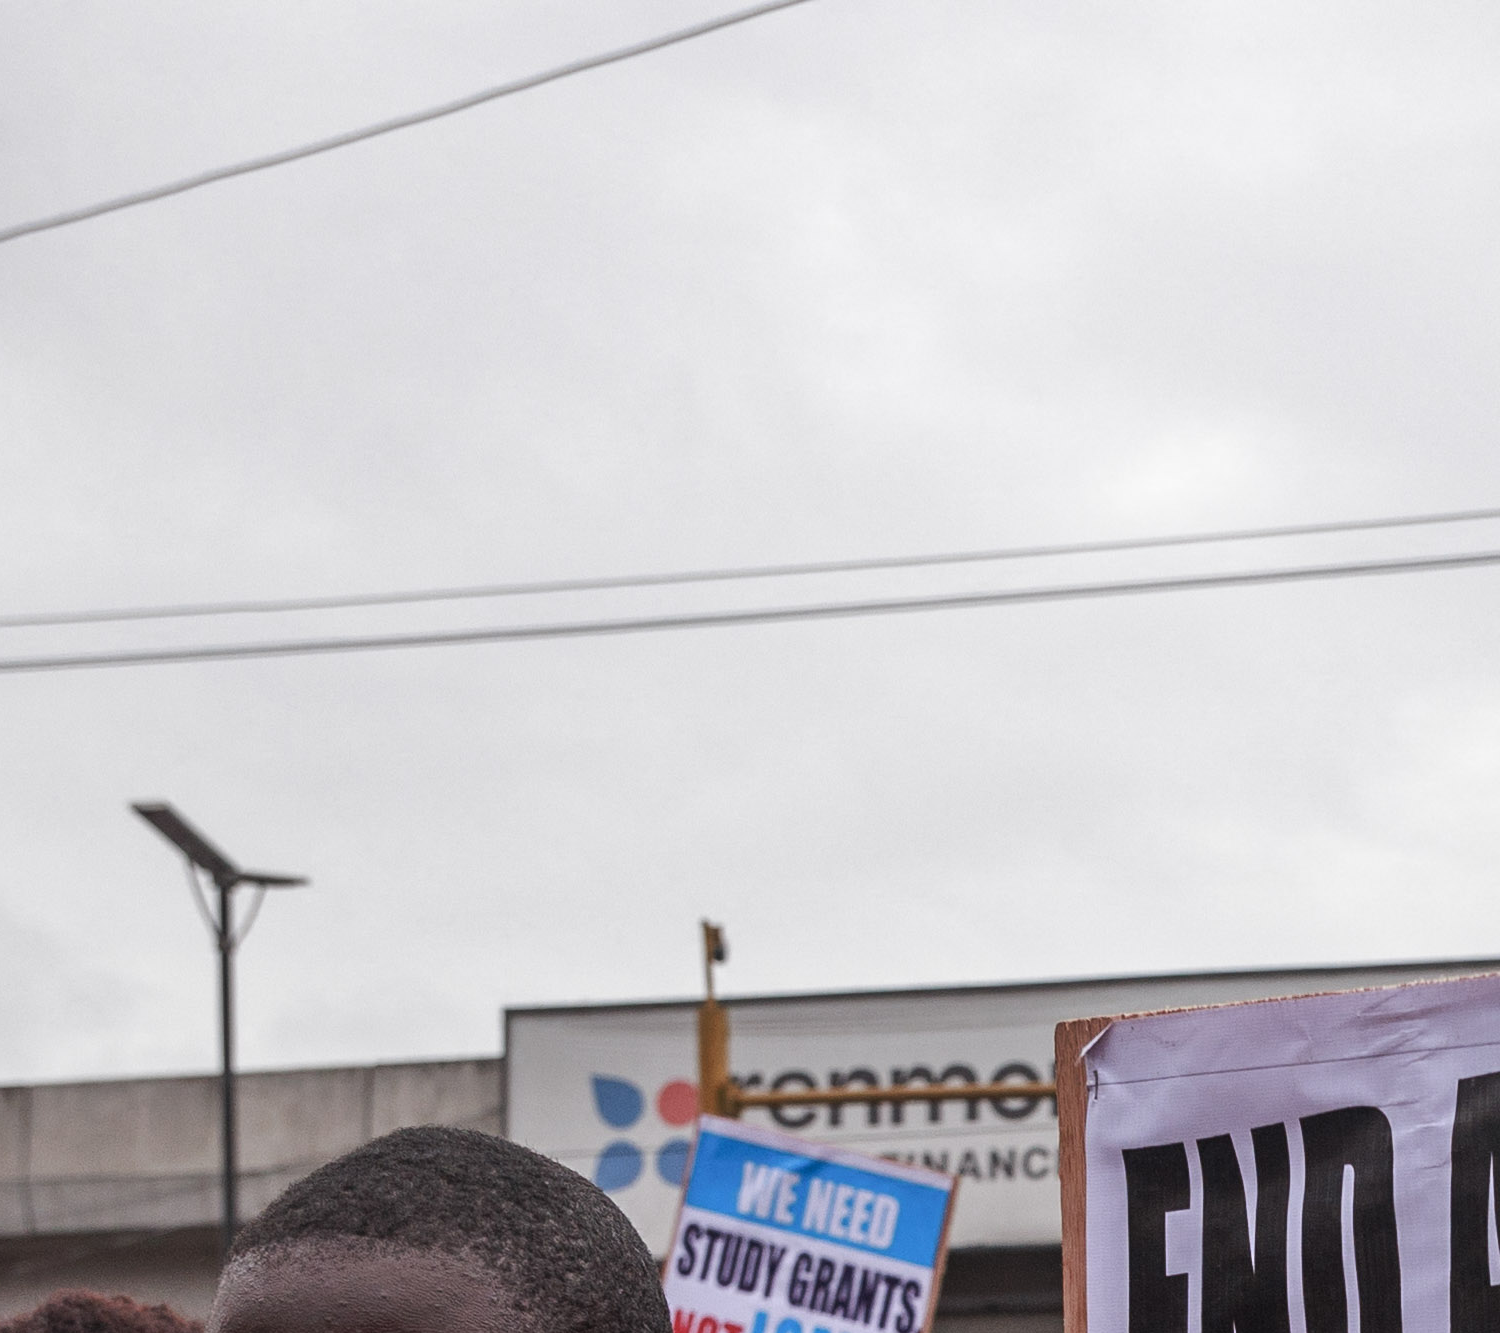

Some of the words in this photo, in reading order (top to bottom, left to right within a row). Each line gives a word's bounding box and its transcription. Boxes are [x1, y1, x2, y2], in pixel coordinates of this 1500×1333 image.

[732, 1062, 1058, 1128] renmo
[736, 1161, 800, 1225] WE
[802, 1177, 900, 1250] NEED
[677, 1223, 786, 1298] STUDY
